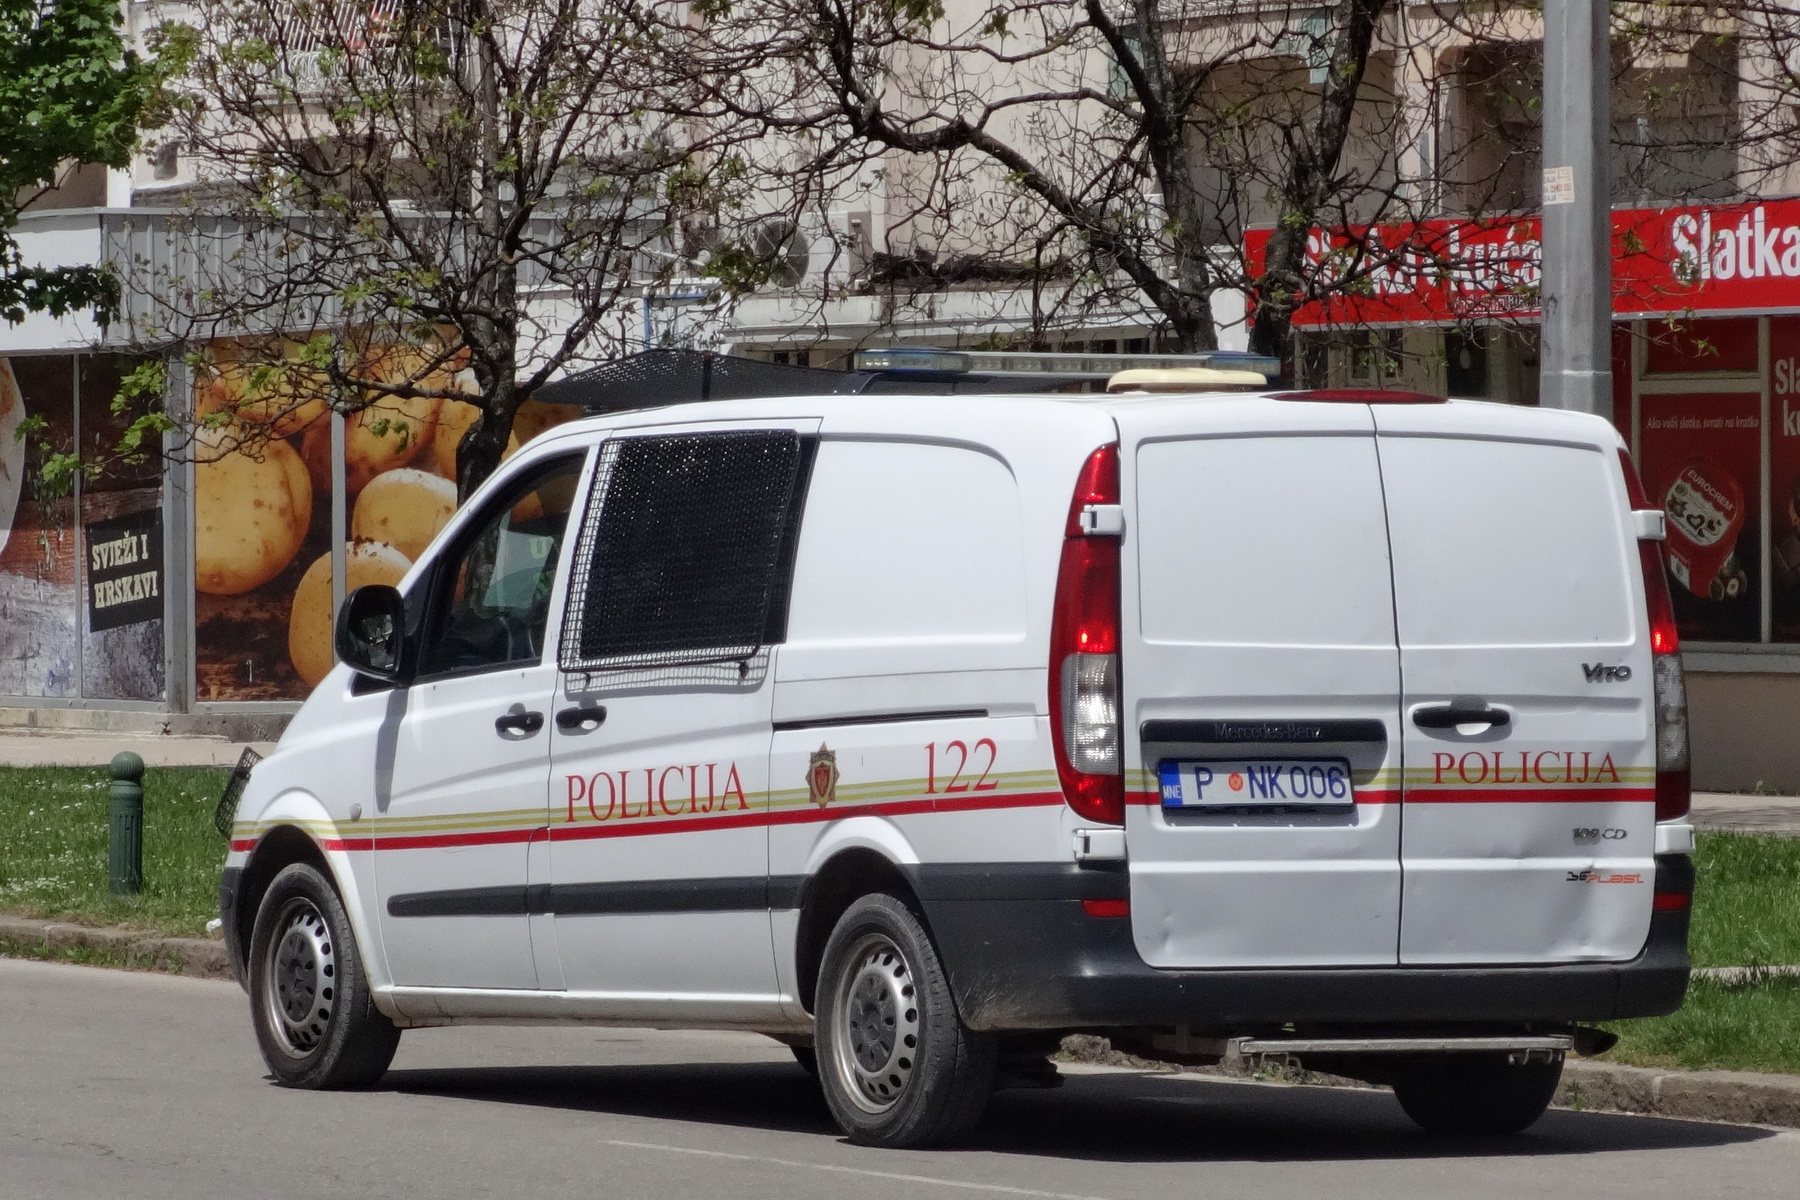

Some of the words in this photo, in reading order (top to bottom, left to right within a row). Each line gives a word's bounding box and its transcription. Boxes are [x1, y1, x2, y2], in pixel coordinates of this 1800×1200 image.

[1672, 206, 1800, 280] Slatka
[1687, 469, 1734, 511] EUROCREM
[92, 530, 138, 571] SVJEŽI
[140, 534, 149, 560] I
[93, 570, 158, 609] HRSKAVI
[1214, 722, 1322, 739] Mercedes-Benz
[924, 737, 999, 795] 122
[1194, 766, 1214, 800] P
[1431, 750, 1622, 784] POLICIJA
[564, 760, 750, 823] POLICIJA
[1162, 784, 1182, 799] MNE
